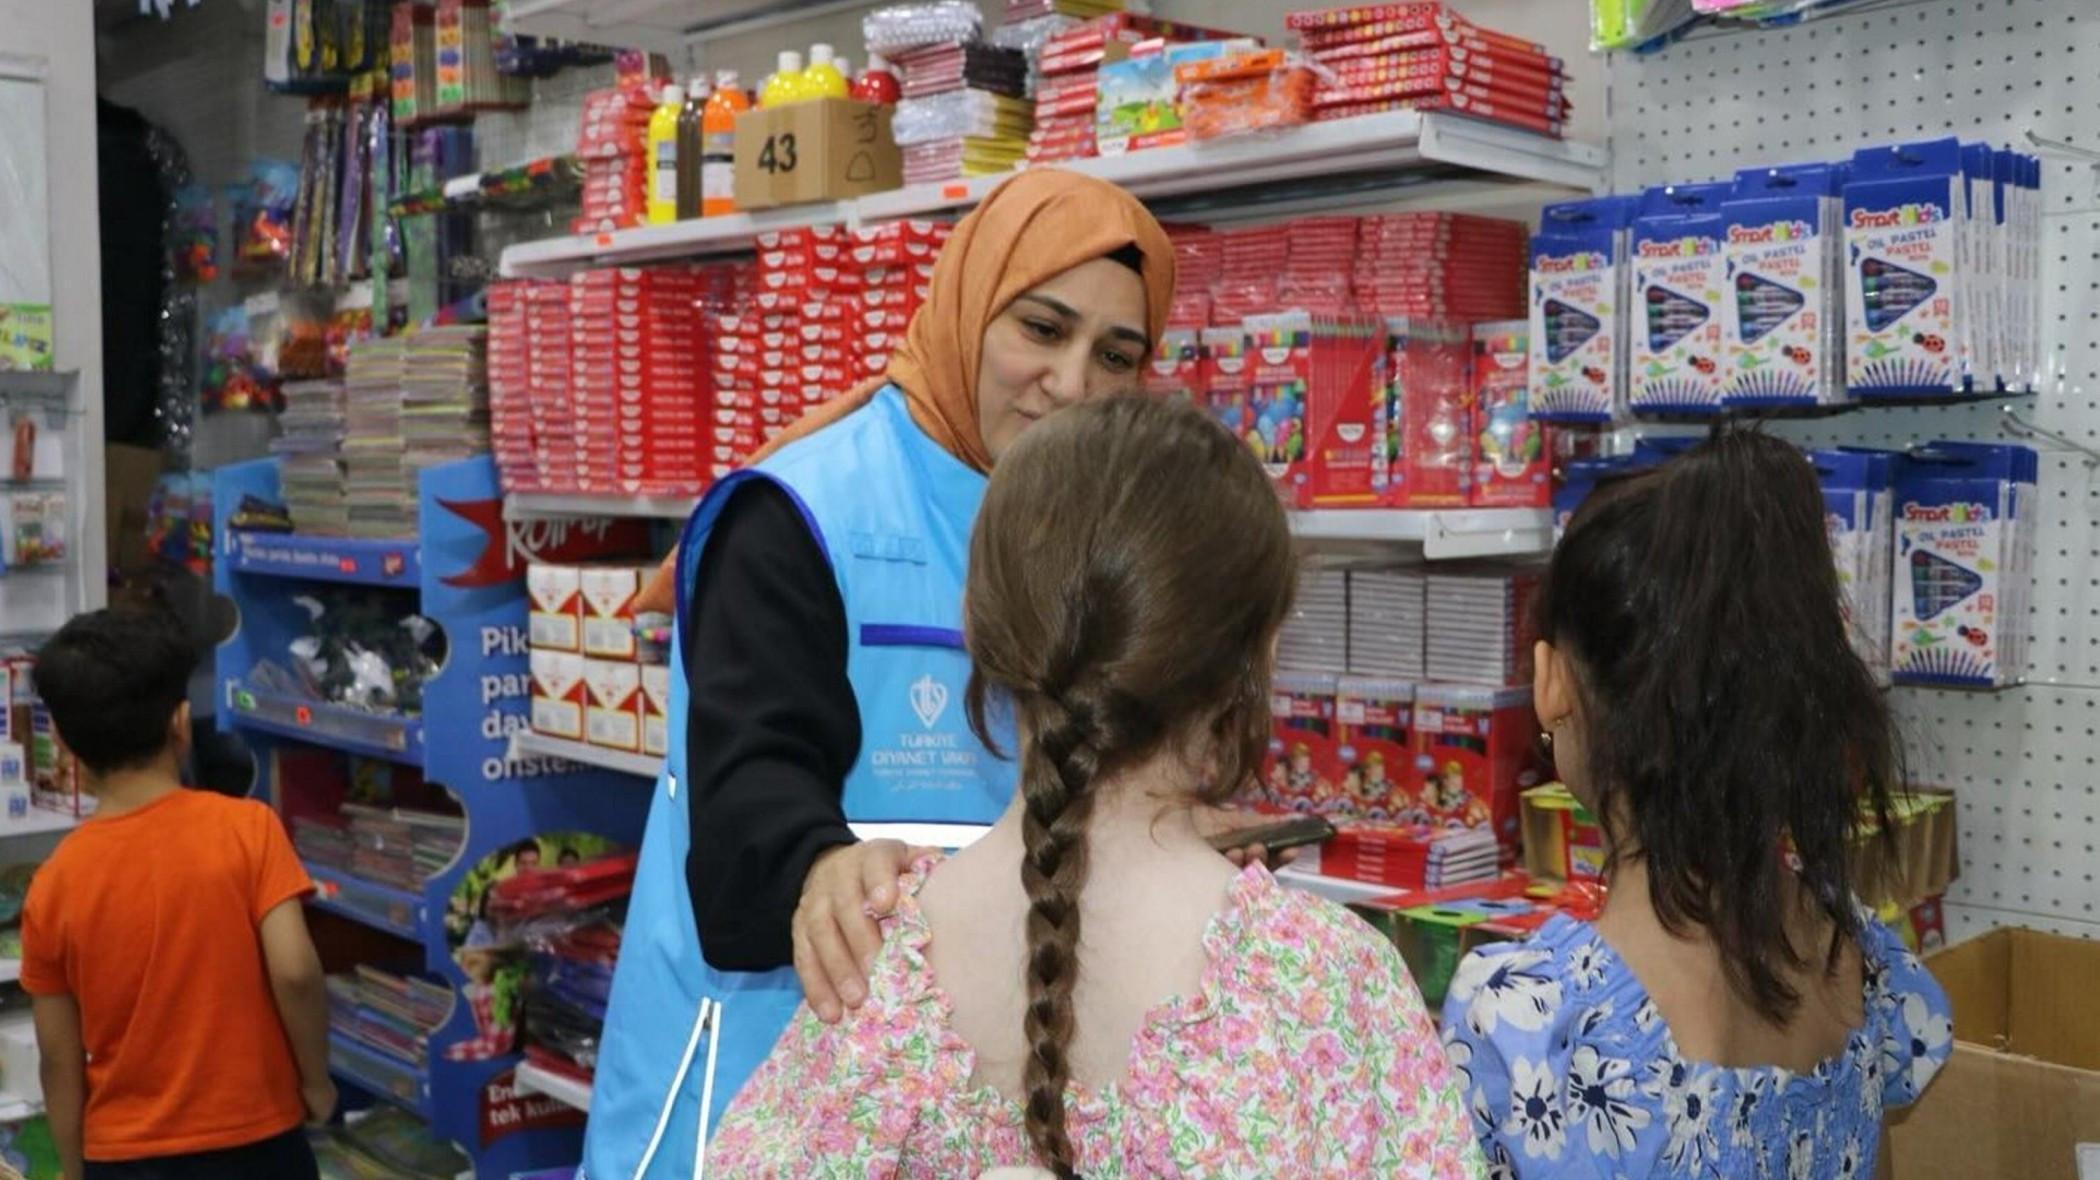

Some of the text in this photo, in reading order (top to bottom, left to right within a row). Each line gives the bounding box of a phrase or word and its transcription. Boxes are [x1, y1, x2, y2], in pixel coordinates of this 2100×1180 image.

[757, 132, 797, 174] 43
[1890, 228, 1936, 244] PASTEL
[1764, 244, 1806, 258] PASTEL
[1885, 242, 1931, 255] PASTEL
[1941, 527, 1984, 540] PASTEL
[1936, 540, 1978, 552] PASTEL
[489, 1103, 520, 1125] tek
